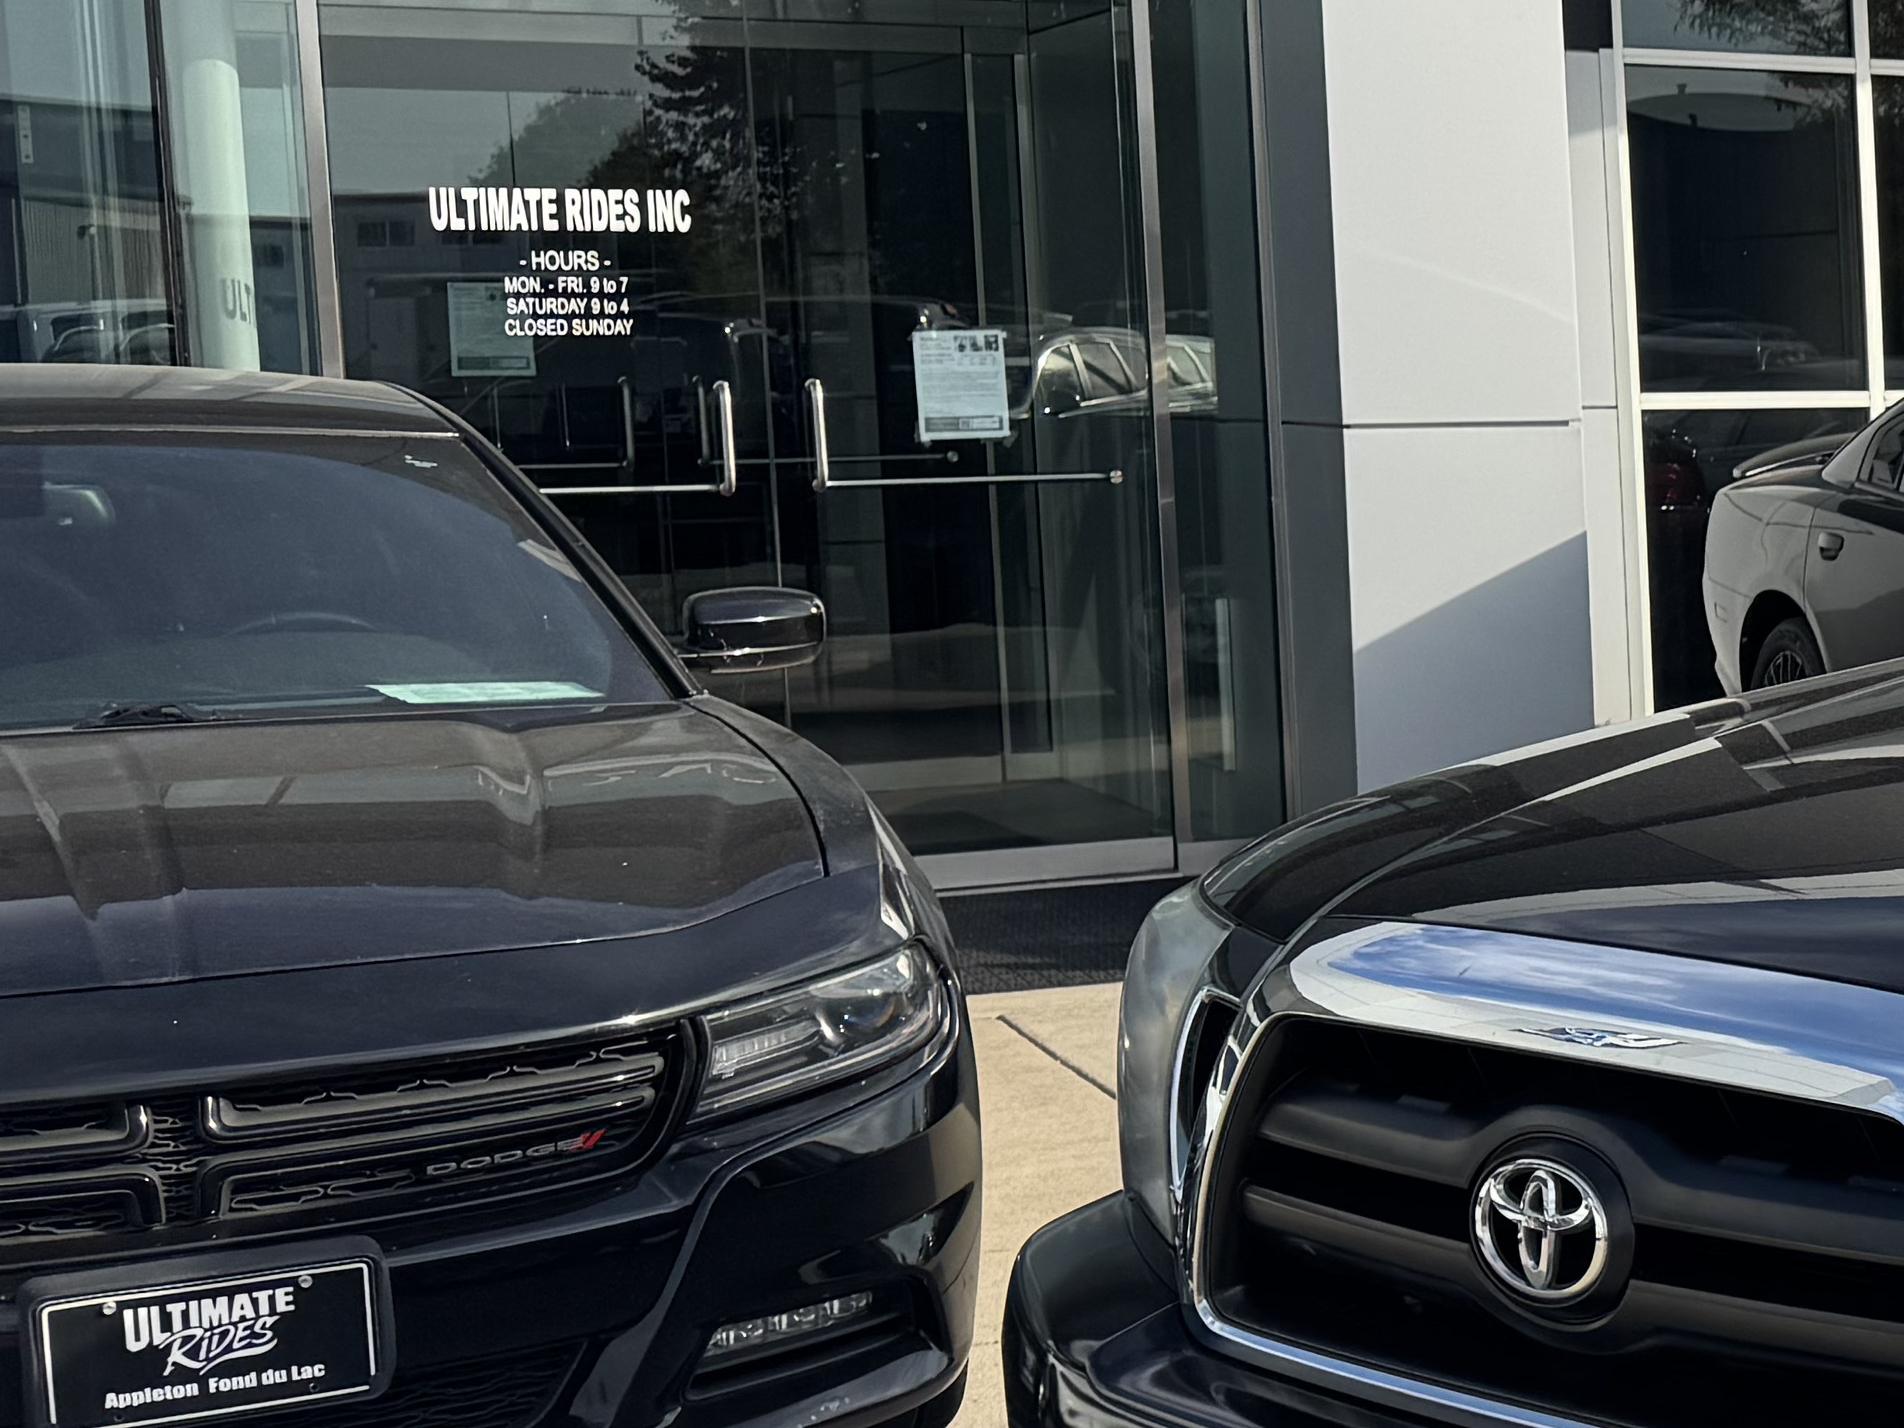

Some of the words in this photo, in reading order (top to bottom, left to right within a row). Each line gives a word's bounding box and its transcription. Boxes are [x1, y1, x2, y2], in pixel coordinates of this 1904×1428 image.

[428, 186, 560, 232] ULTIMATE
[565, 188, 641, 232] RIDES
[647, 189, 692, 233] INC
[531, 250, 599, 271] HOURS
[504, 277, 544, 294] MON.
[558, 277, 587, 293] FRI.
[590, 277, 600, 293] 9
[603, 277, 617, 293] to
[620, 277, 628, 292] 7
[507, 298, 587, 314] SATURDAY
[591, 298, 600, 314] 9
[604, 298, 617, 314] to
[620, 298, 629, 314] 4
[505, 319, 568, 336] CLOSED
[572, 319, 633, 336] SUNDAY
[426, 1136, 584, 1176] DODGE
[122, 1285, 296, 1353] ULTIMATE
[104, 1381, 199, 1410] Appleton
[208, 1370, 258, 1394] Fond
[262, 1368, 287, 1386] du
[291, 1363, 326, 1381] Lac
